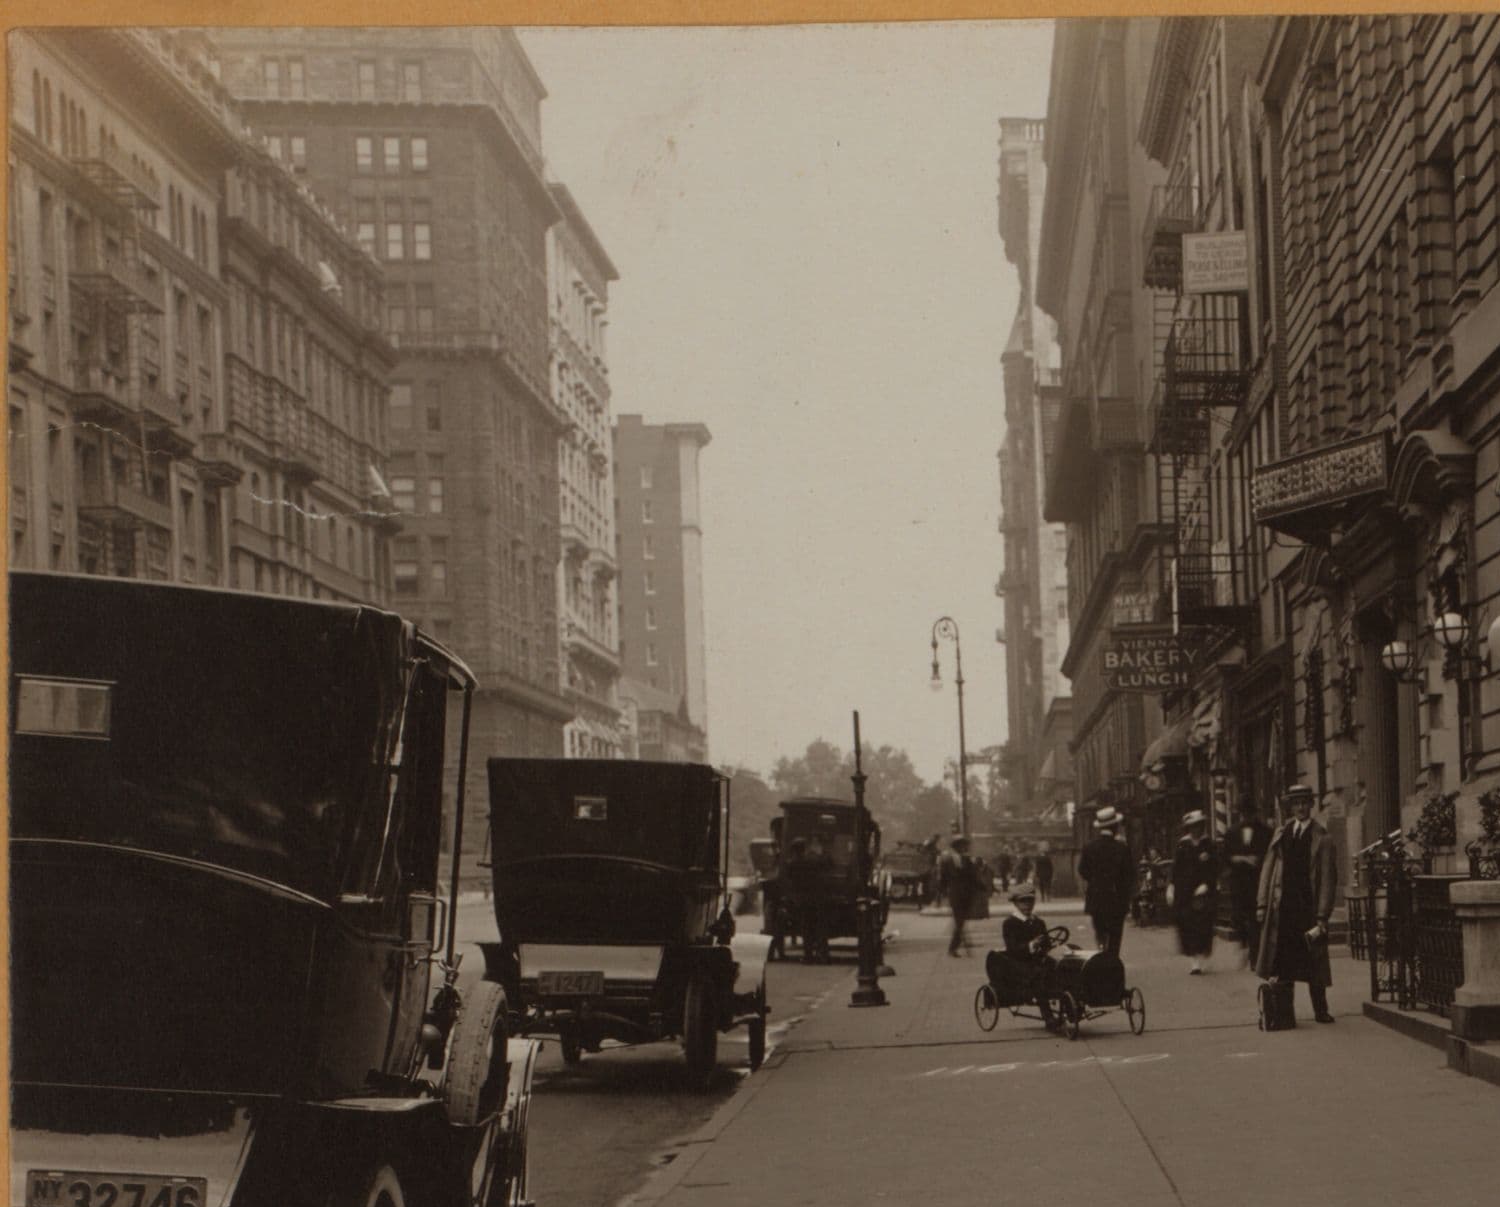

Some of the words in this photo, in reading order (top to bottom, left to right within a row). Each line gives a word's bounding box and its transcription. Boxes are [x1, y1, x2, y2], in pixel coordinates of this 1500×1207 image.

[1121, 639, 1179, 649] VIENNA
[1105, 649, 1198, 668] BAKERY
[1118, 672, 1188, 686] LUNCH
[33, 1180, 63, 1198] NY
